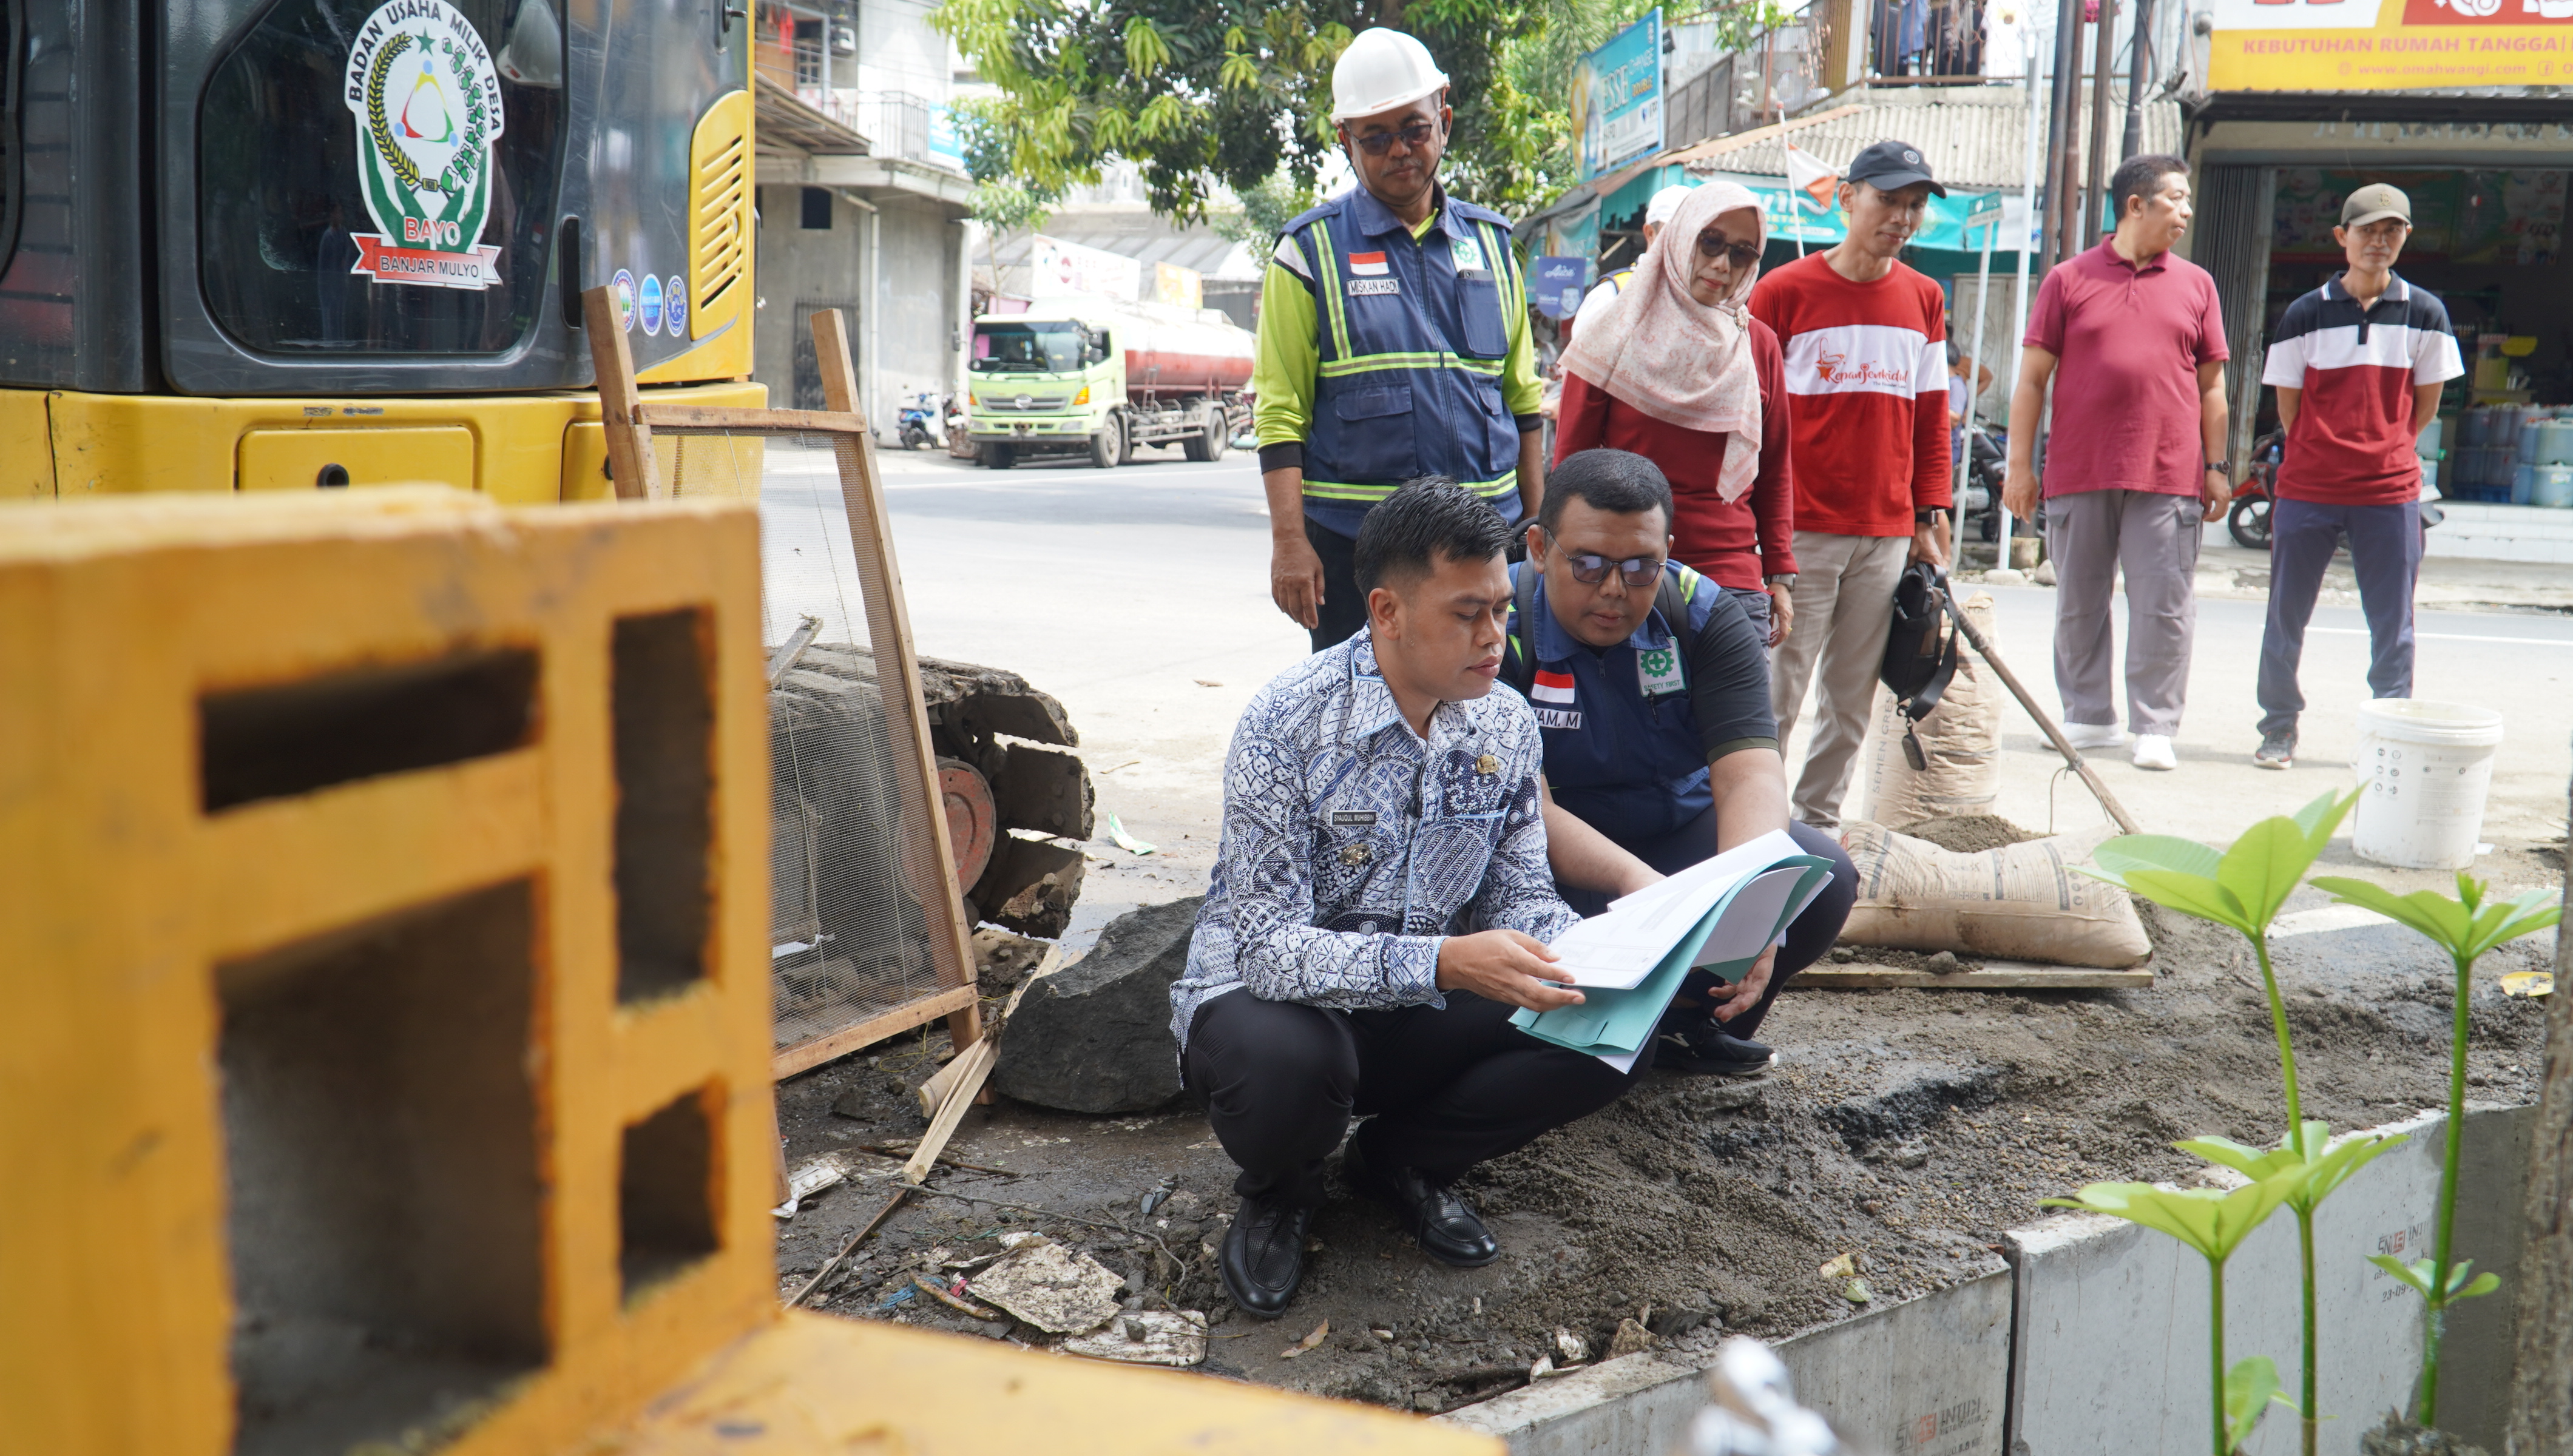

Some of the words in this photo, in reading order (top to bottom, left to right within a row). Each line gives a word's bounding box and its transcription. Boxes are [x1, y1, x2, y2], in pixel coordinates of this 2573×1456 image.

[2243, 38, 2373, 53] KEBUTUHAN
[2379, 37, 2460, 52] RUMAH
[2467, 36, 2558, 52] TANGGA
[349, 20, 384, 102] BADAN
[386, 0, 441, 25] USAHA
[450, 13, 487, 67] MILIK
[485, 75, 501, 131] DESA
[2359, 62, 2526, 76] www.omahwangi.com
[1601, 64, 1629, 115] ESSE
[404, 217, 461, 246] BAYO
[381, 257, 434, 274] BANJAR
[439, 258, 479, 278] MULYO
[1350, 280, 1379, 294] MISKAN
[1379, 280, 1398, 292] HADI
[1644, 682, 1663, 691] SAFETY
[1666, 679, 1680, 688] FIRST
[1535, 709, 1560, 727] AM.
[1566, 713, 1579, 727] M
[1872, 741, 1887, 794] SEMEN
[1882, 691, 1894, 735] GRESI
